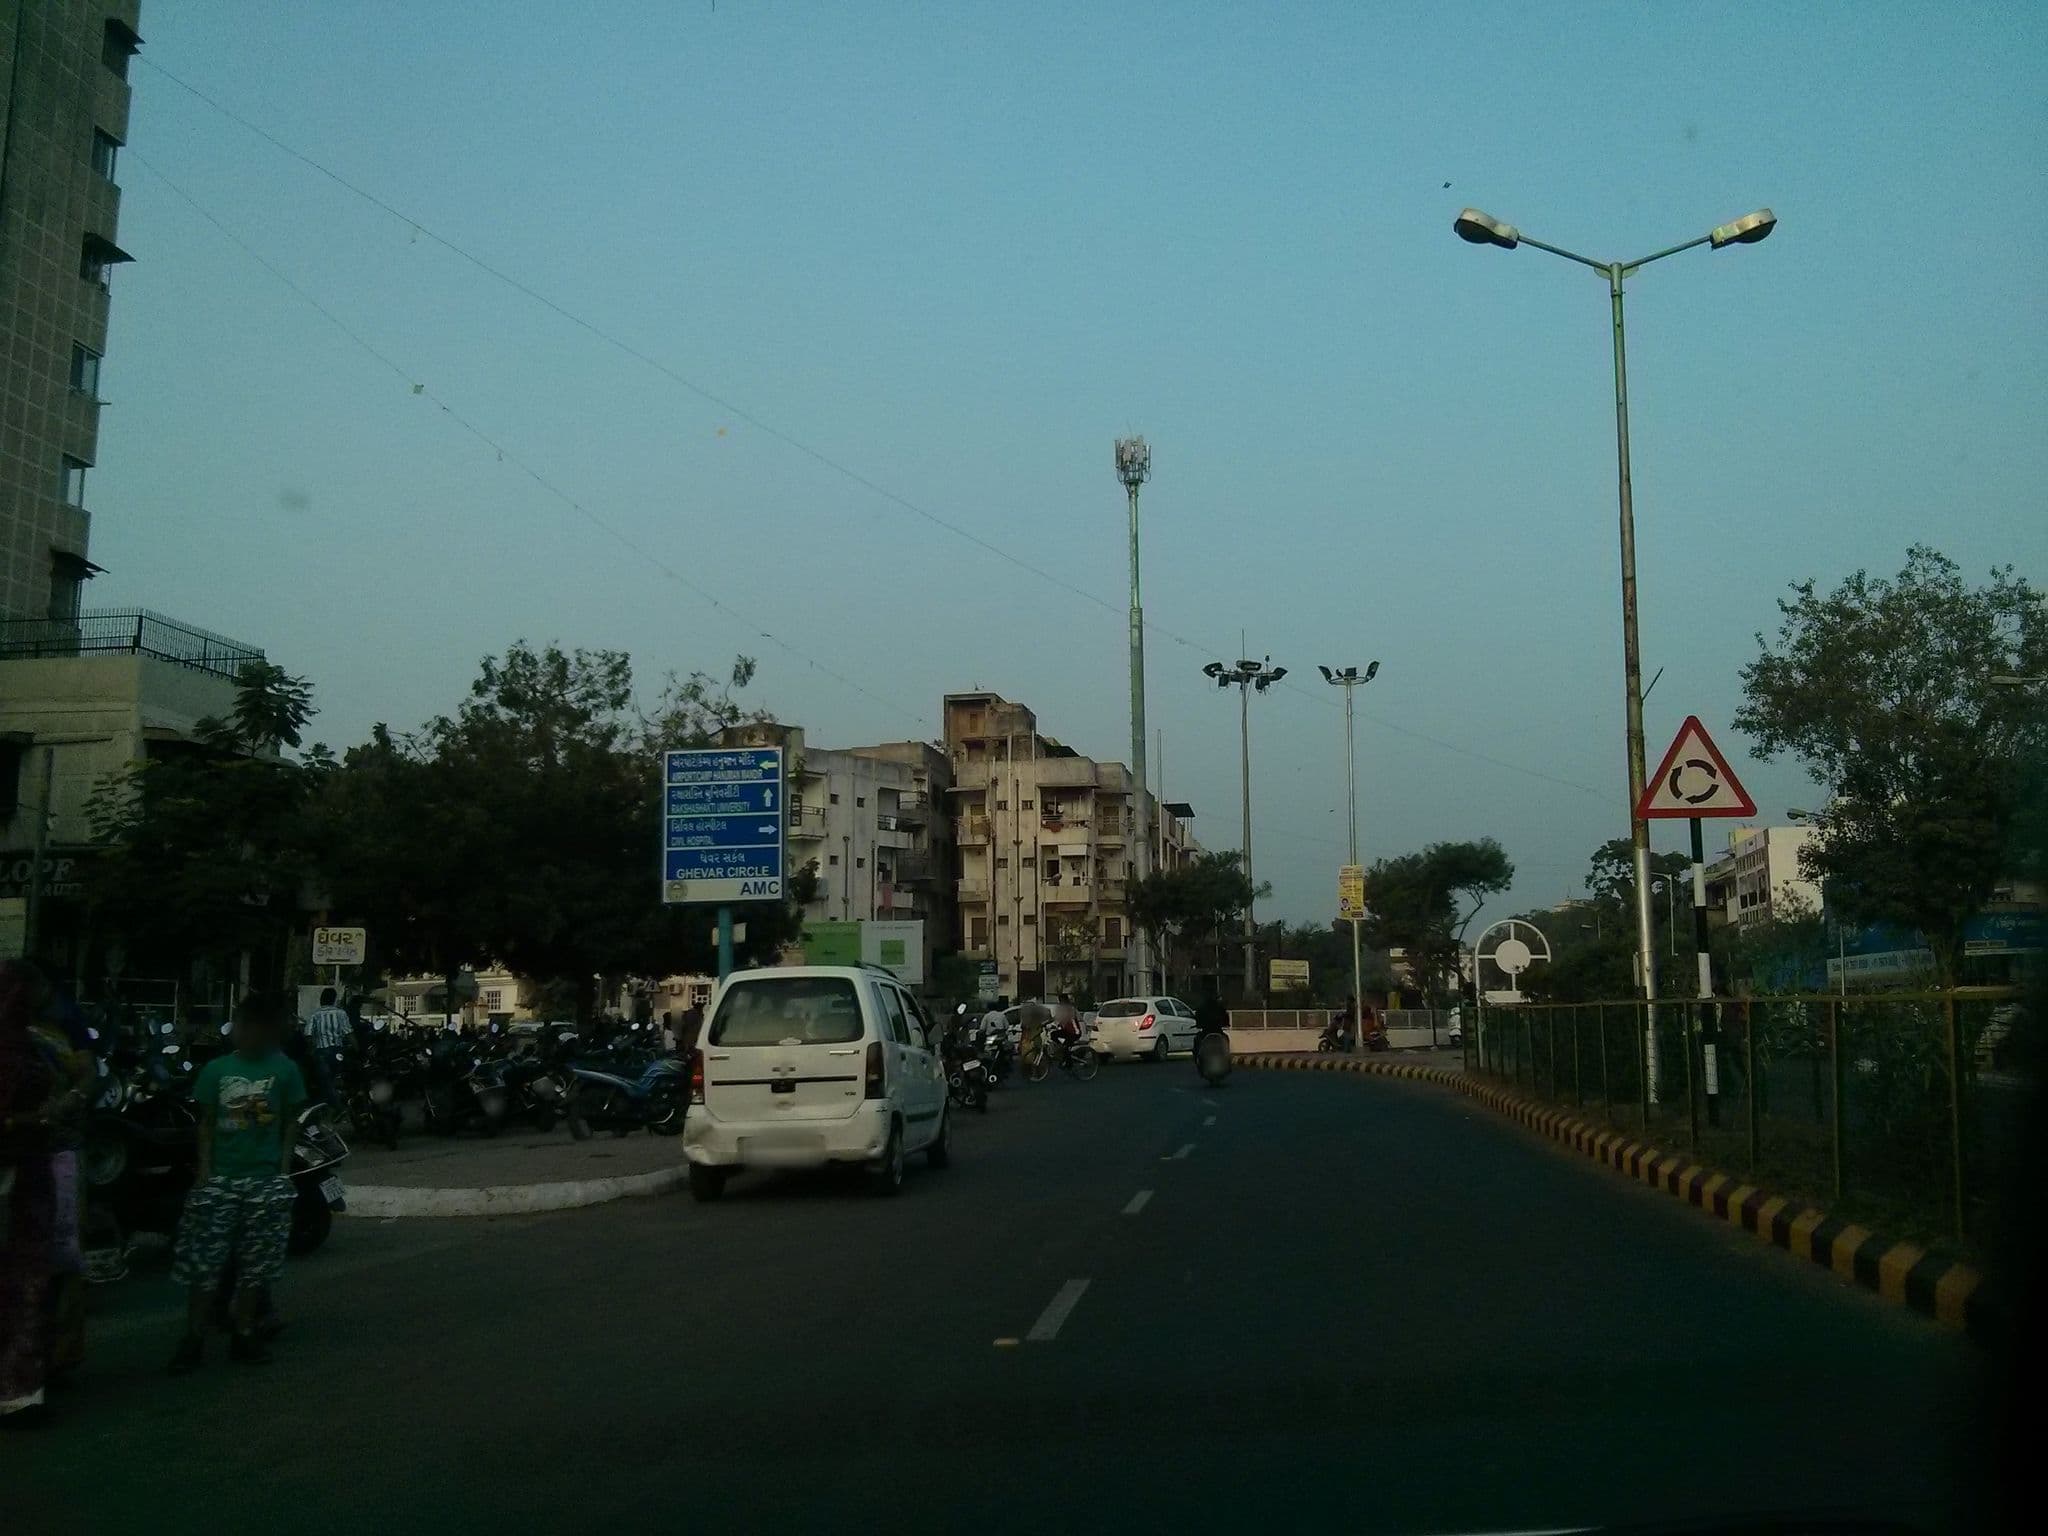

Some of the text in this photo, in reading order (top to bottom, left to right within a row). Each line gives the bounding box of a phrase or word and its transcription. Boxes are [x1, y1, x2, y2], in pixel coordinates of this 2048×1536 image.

[676, 866, 770, 879] GHEVAR CIRCLE
[740, 881, 780, 896] AMC
